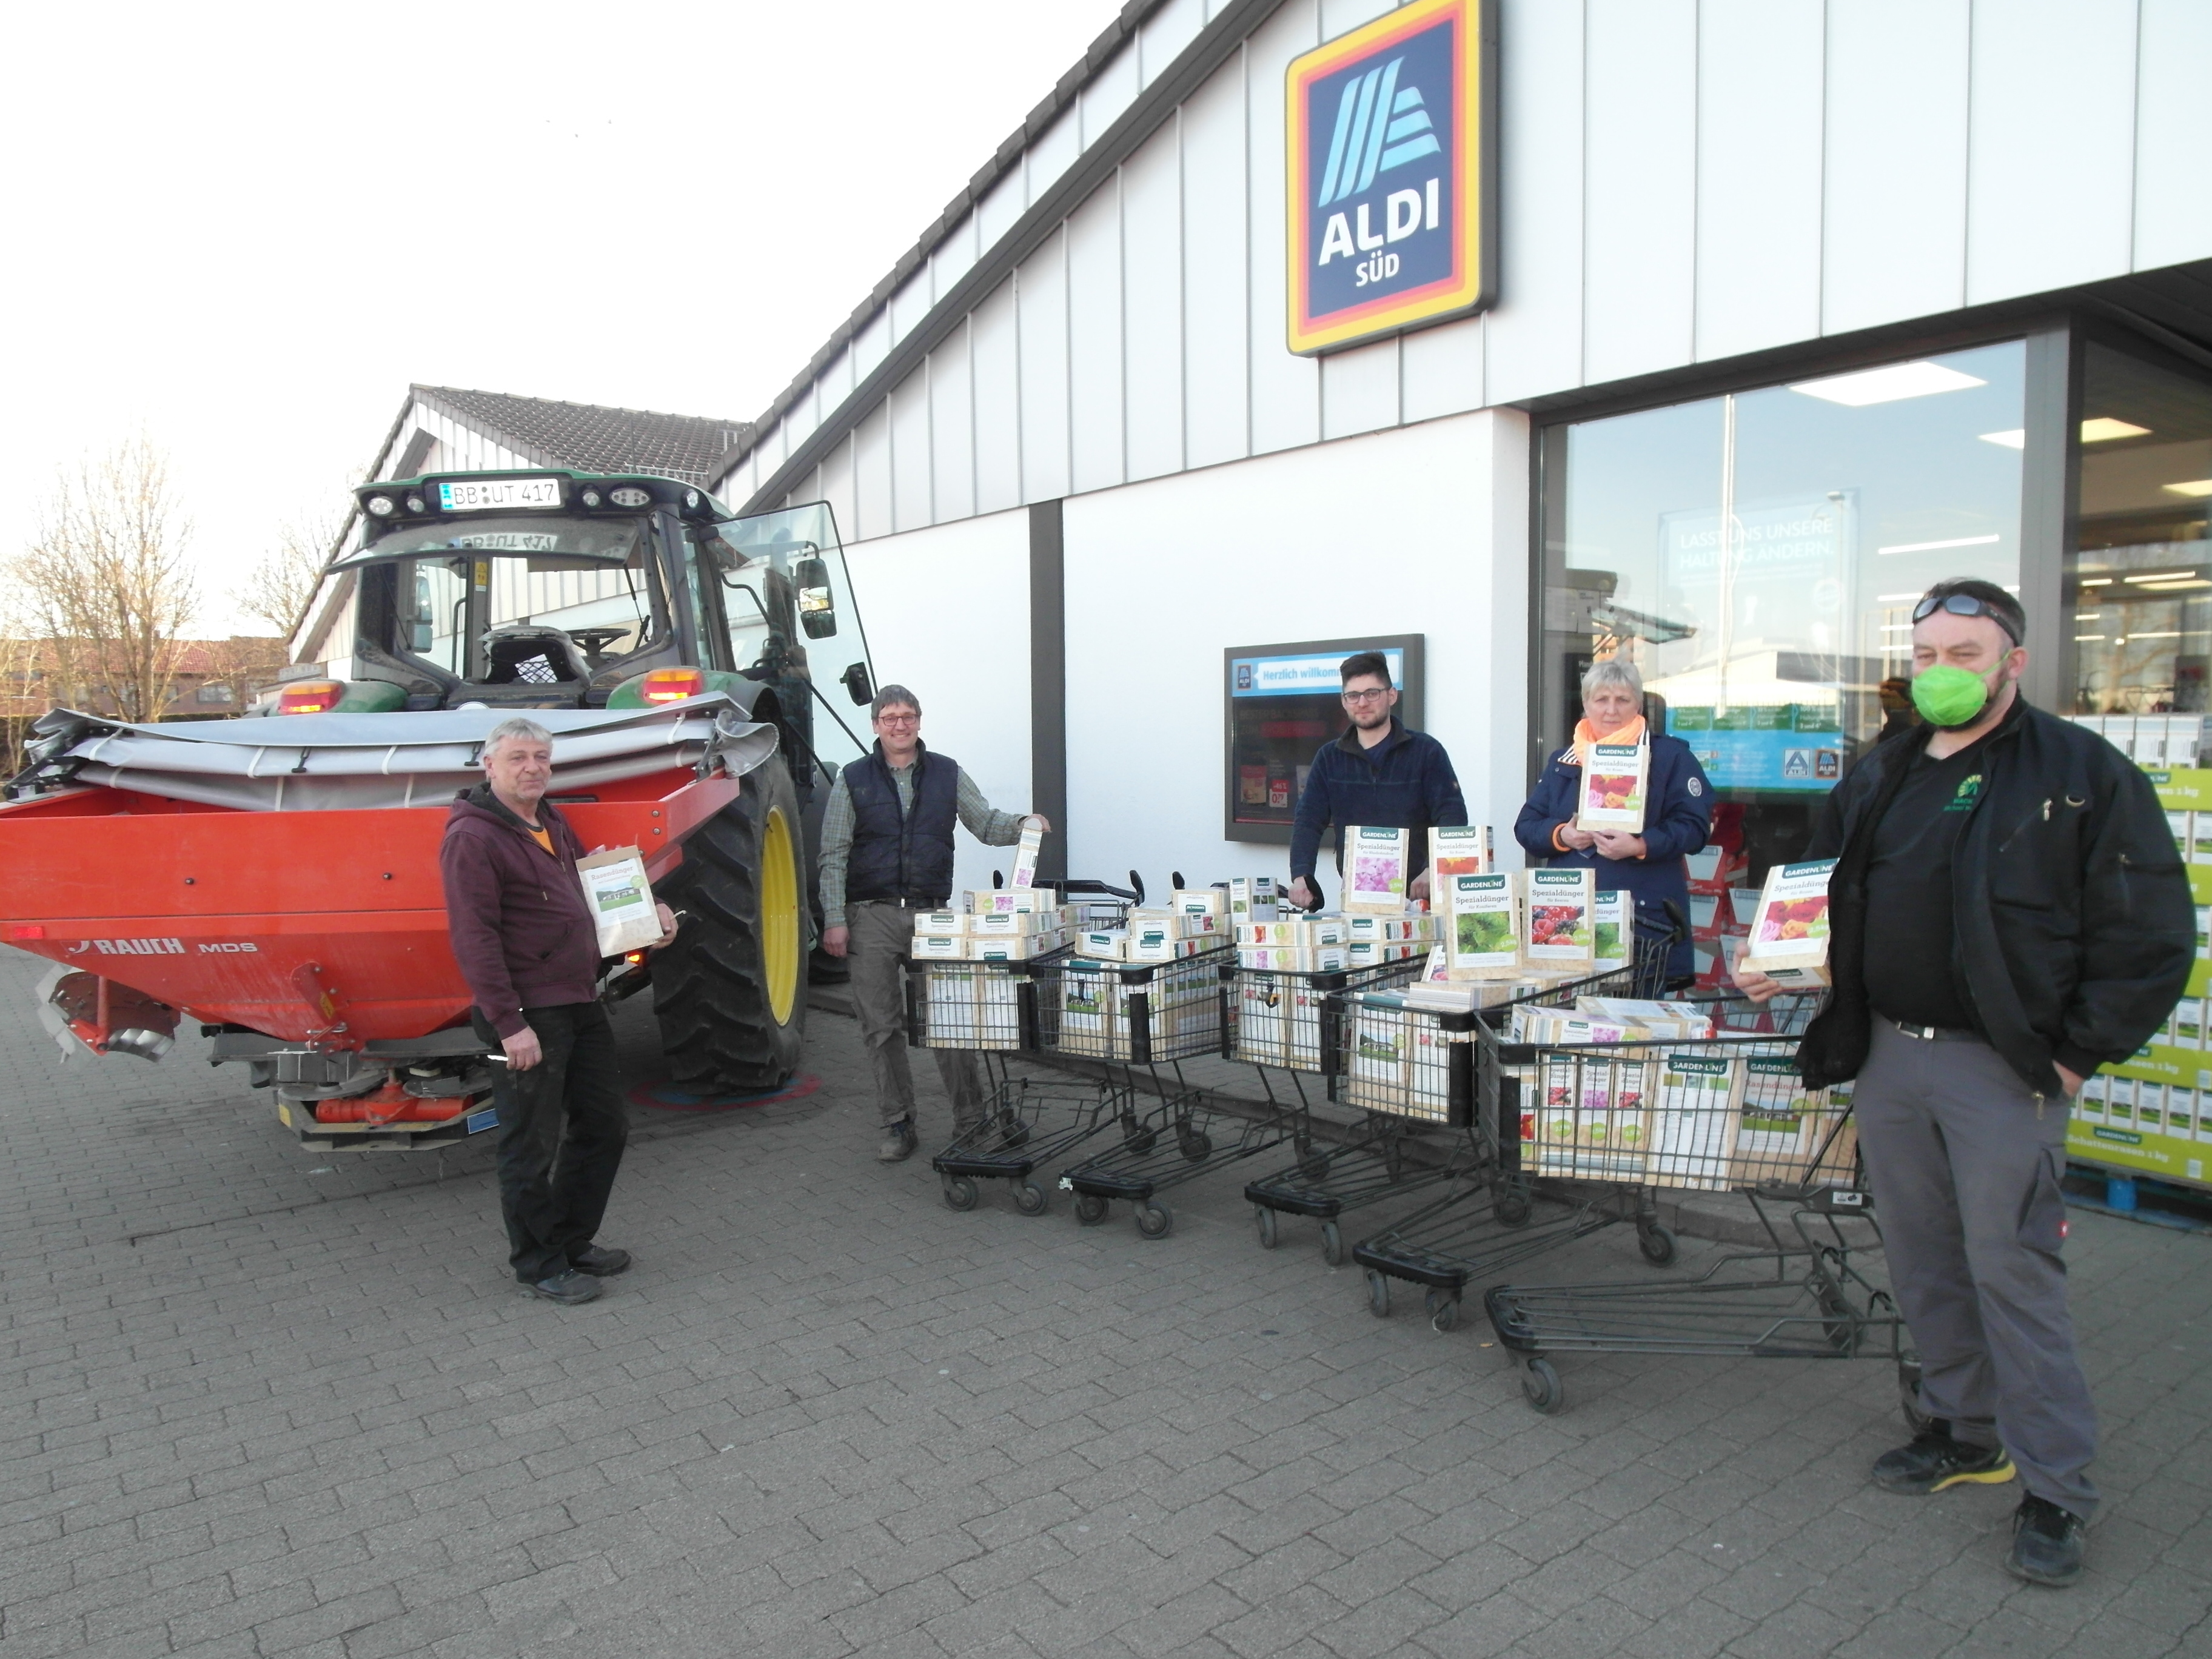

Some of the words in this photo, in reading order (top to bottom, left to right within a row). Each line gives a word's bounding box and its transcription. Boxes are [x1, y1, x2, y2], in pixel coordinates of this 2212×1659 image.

[1318, 177, 1439, 267] ALDI
[1355, 251, 1400, 287] SÜD
[454, 487, 478, 504] BB
[492, 486, 514, 503] UT
[522, 484, 554, 502] 417
[1729, 525, 1761, 543] UNS
[1766, 517, 1834, 540] UNSERE
[1756, 540, 1835, 562] ÄNDERN.
[1263, 668, 1298, 680] Herzlich
[1592, 760, 1639, 768] Spezialdünger
[591, 865, 634, 881] Rasendünger
[1785, 863, 1833, 877] GARDENLINE
[1460, 880, 1503, 889] GARDENLINE
[1774, 880, 1828, 893] Spezialdüng
[1455, 895, 1509, 905] Spezialdünger
[1532, 889, 1584, 898] Spezialdünger
[93, 938, 186, 955] RAUCH
[198, 942, 258, 953] MDS
